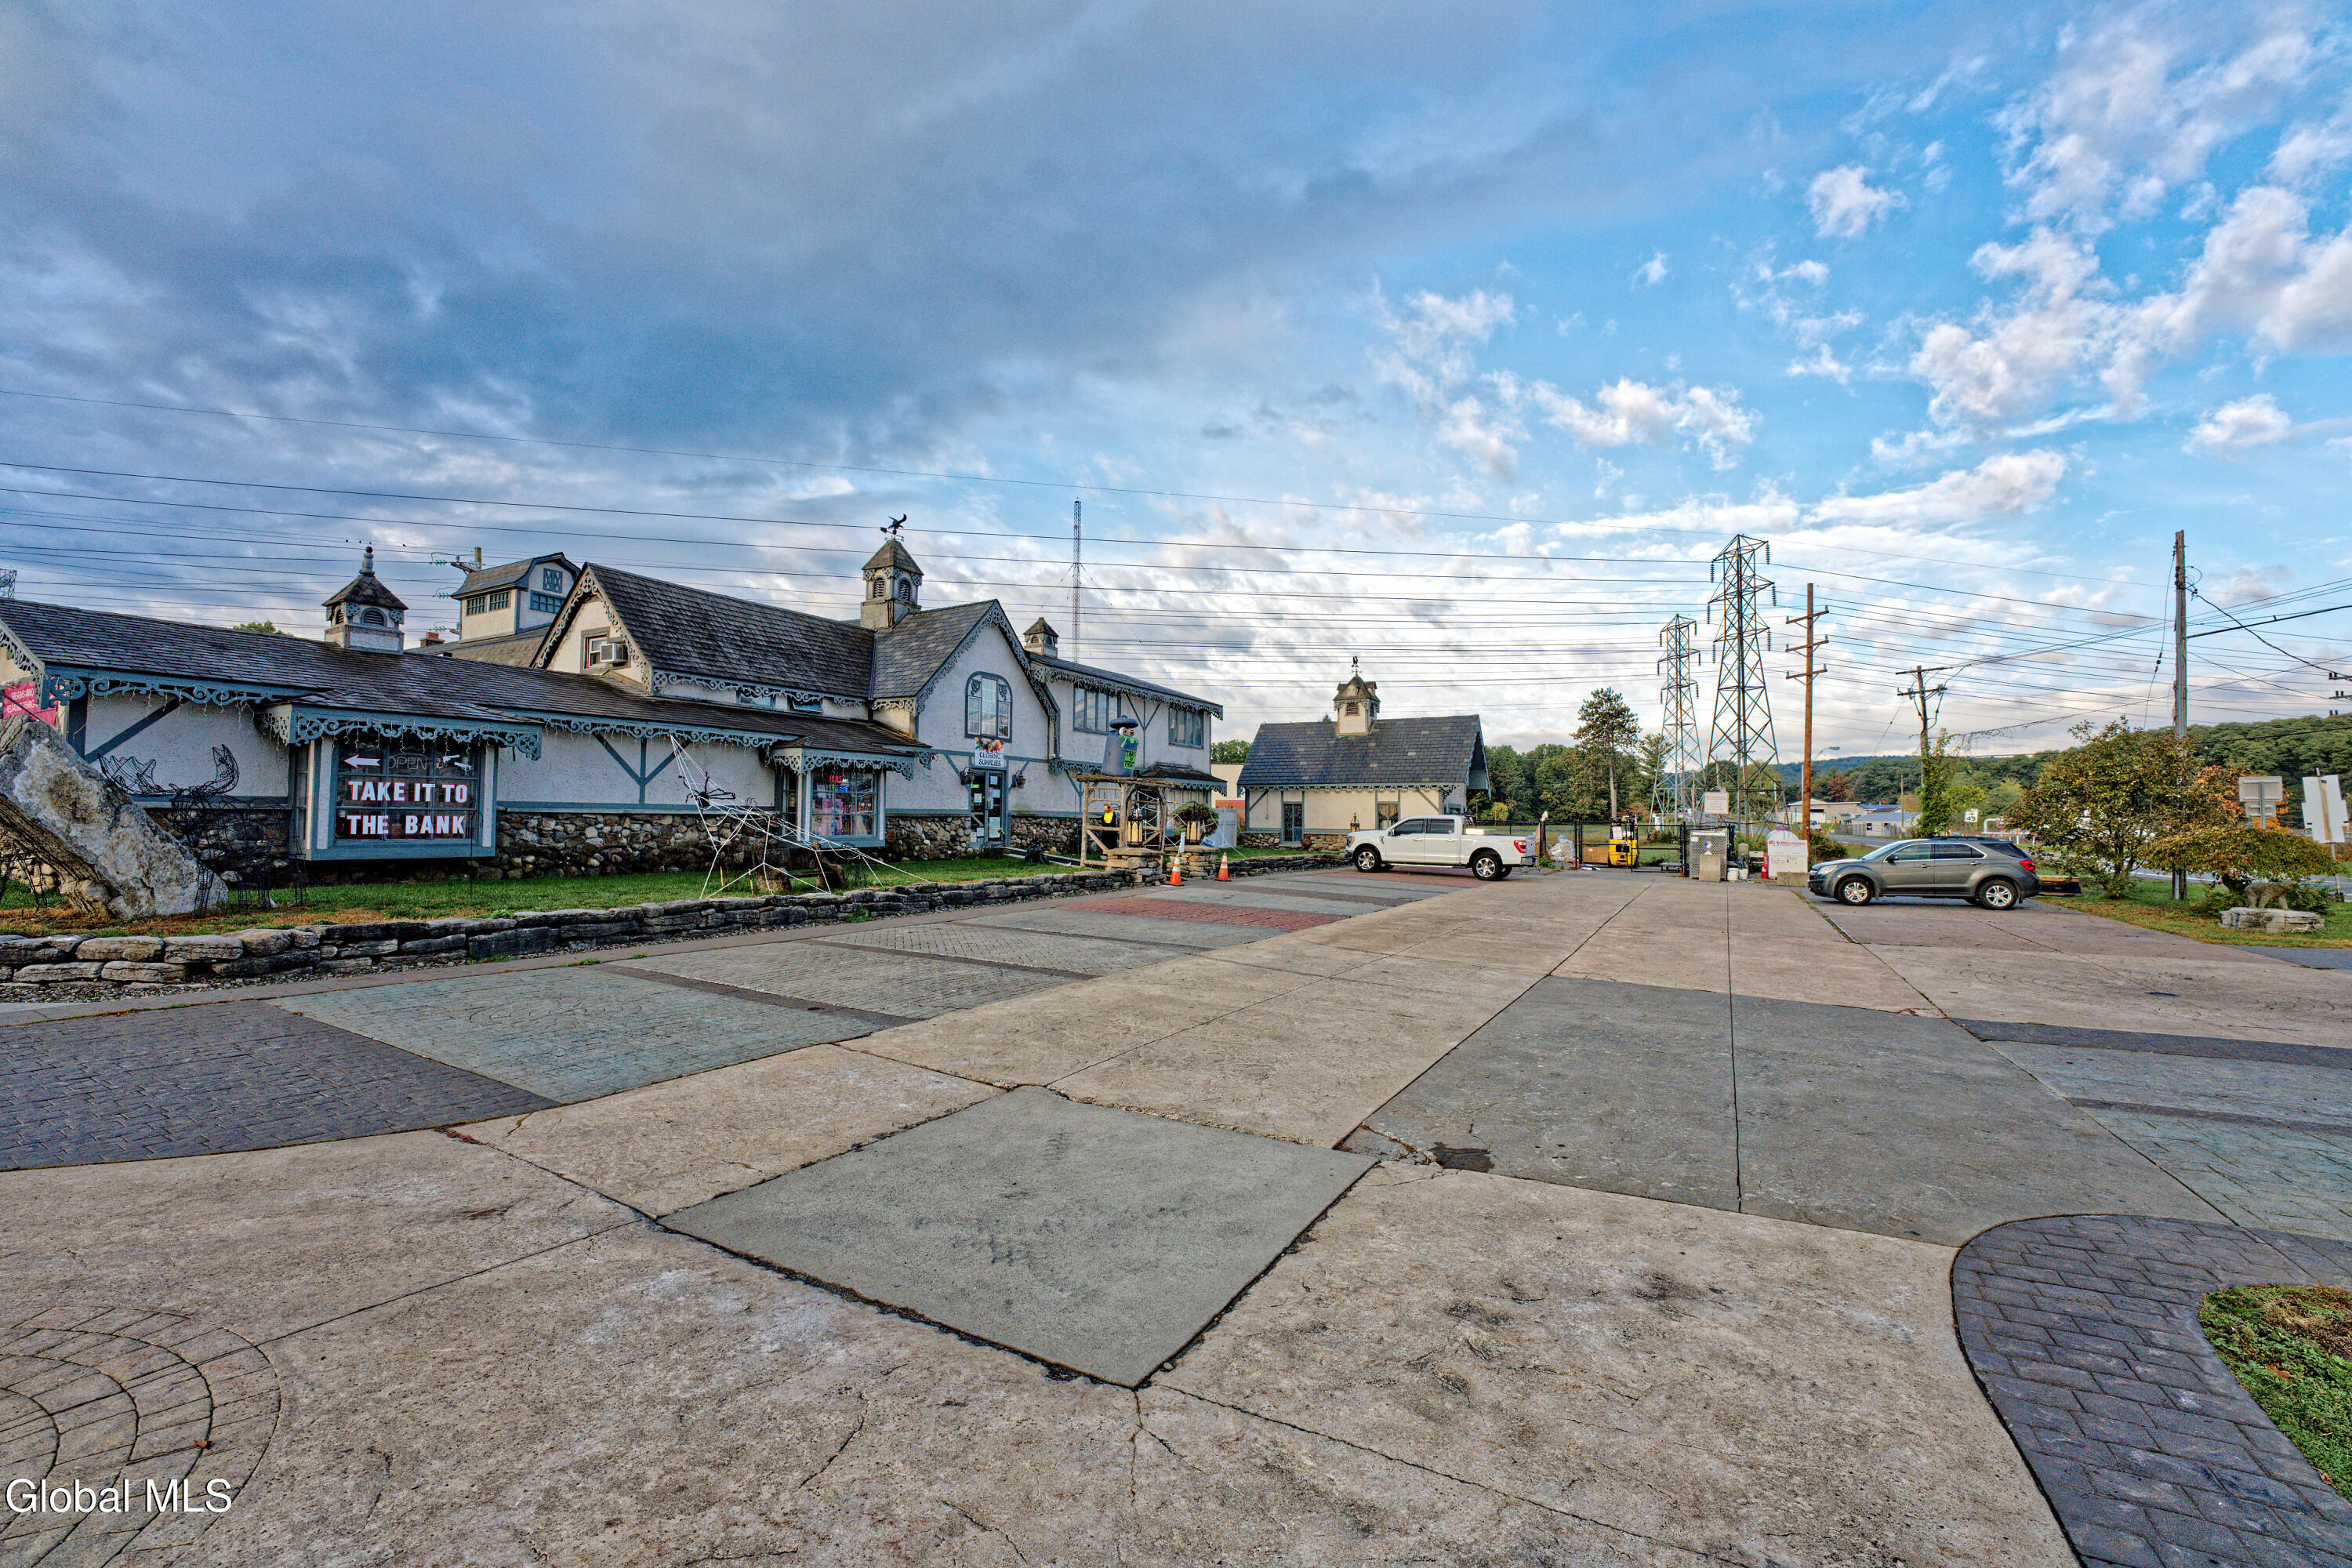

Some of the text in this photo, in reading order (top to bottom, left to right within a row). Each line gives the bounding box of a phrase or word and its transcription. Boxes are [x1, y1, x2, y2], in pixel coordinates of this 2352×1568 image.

[387, 756, 428, 770] OPEN
[348, 780, 468, 803] TAKE IT TO
[347, 815, 465, 835] THE BANK
